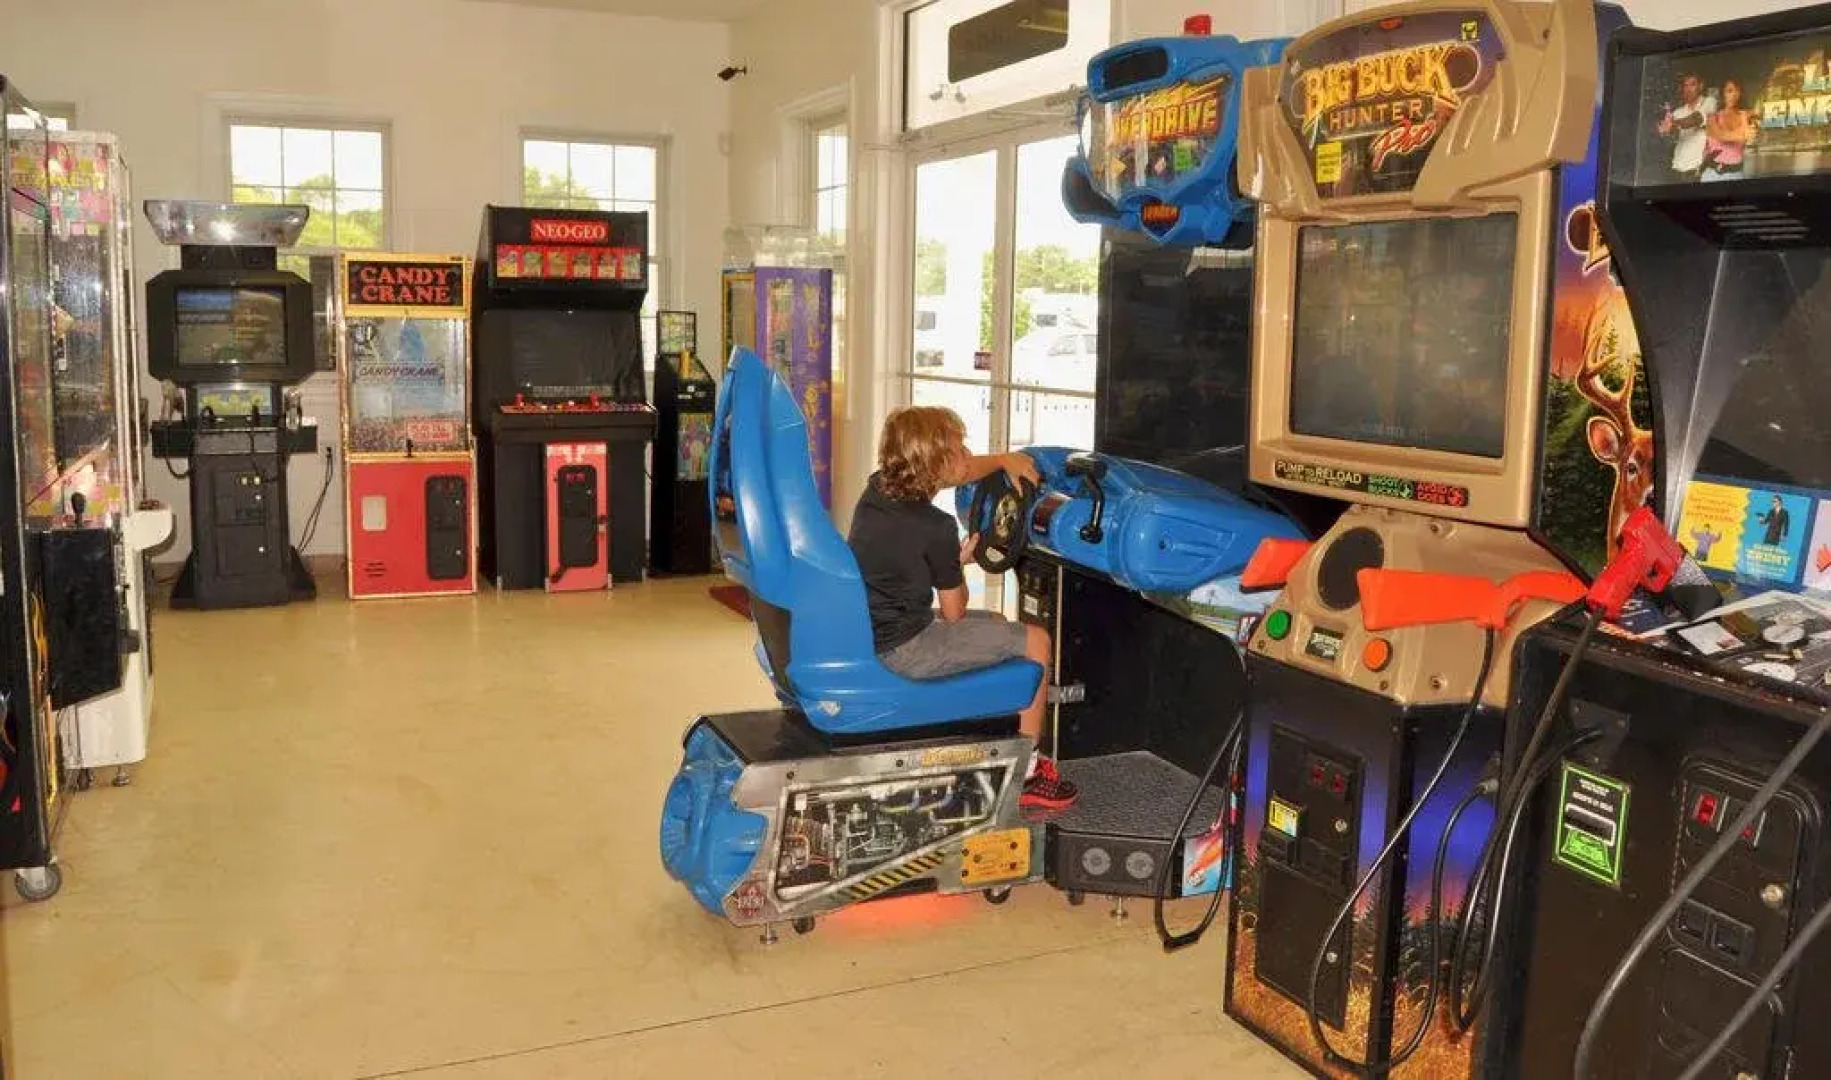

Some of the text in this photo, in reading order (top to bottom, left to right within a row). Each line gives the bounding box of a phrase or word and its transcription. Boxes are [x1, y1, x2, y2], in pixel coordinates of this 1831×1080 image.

[1303, 43, 1460, 122] BIG BUCK
[1329, 99, 1424, 131] HUNTER
[360, 267, 449, 285] CANDY
[361, 285, 449, 303] CRANE
[1277, 460, 1304, 473] PUMP
[1315, 466, 1362, 484] RELOAD
[1416, 482, 1447, 494] AVOID
